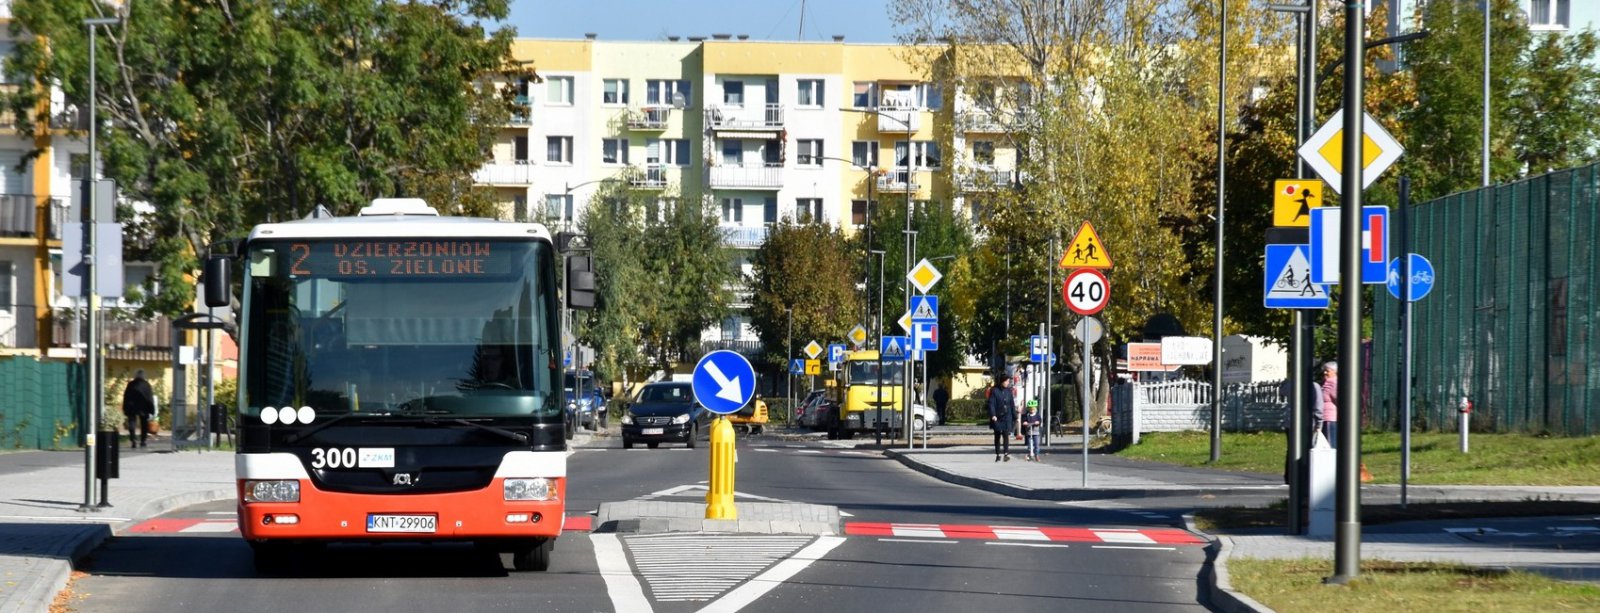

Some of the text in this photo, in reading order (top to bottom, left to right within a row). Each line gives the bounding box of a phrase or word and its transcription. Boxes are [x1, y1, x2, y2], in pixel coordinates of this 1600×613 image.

[289, 243, 311, 275] 2
[338, 259, 485, 275] OS. ZIELONE
[1071, 281, 1103, 302] 40
[832, 346, 843, 361] P
[311, 447, 357, 468] 300
[374, 517, 434, 529] KNT 29906
